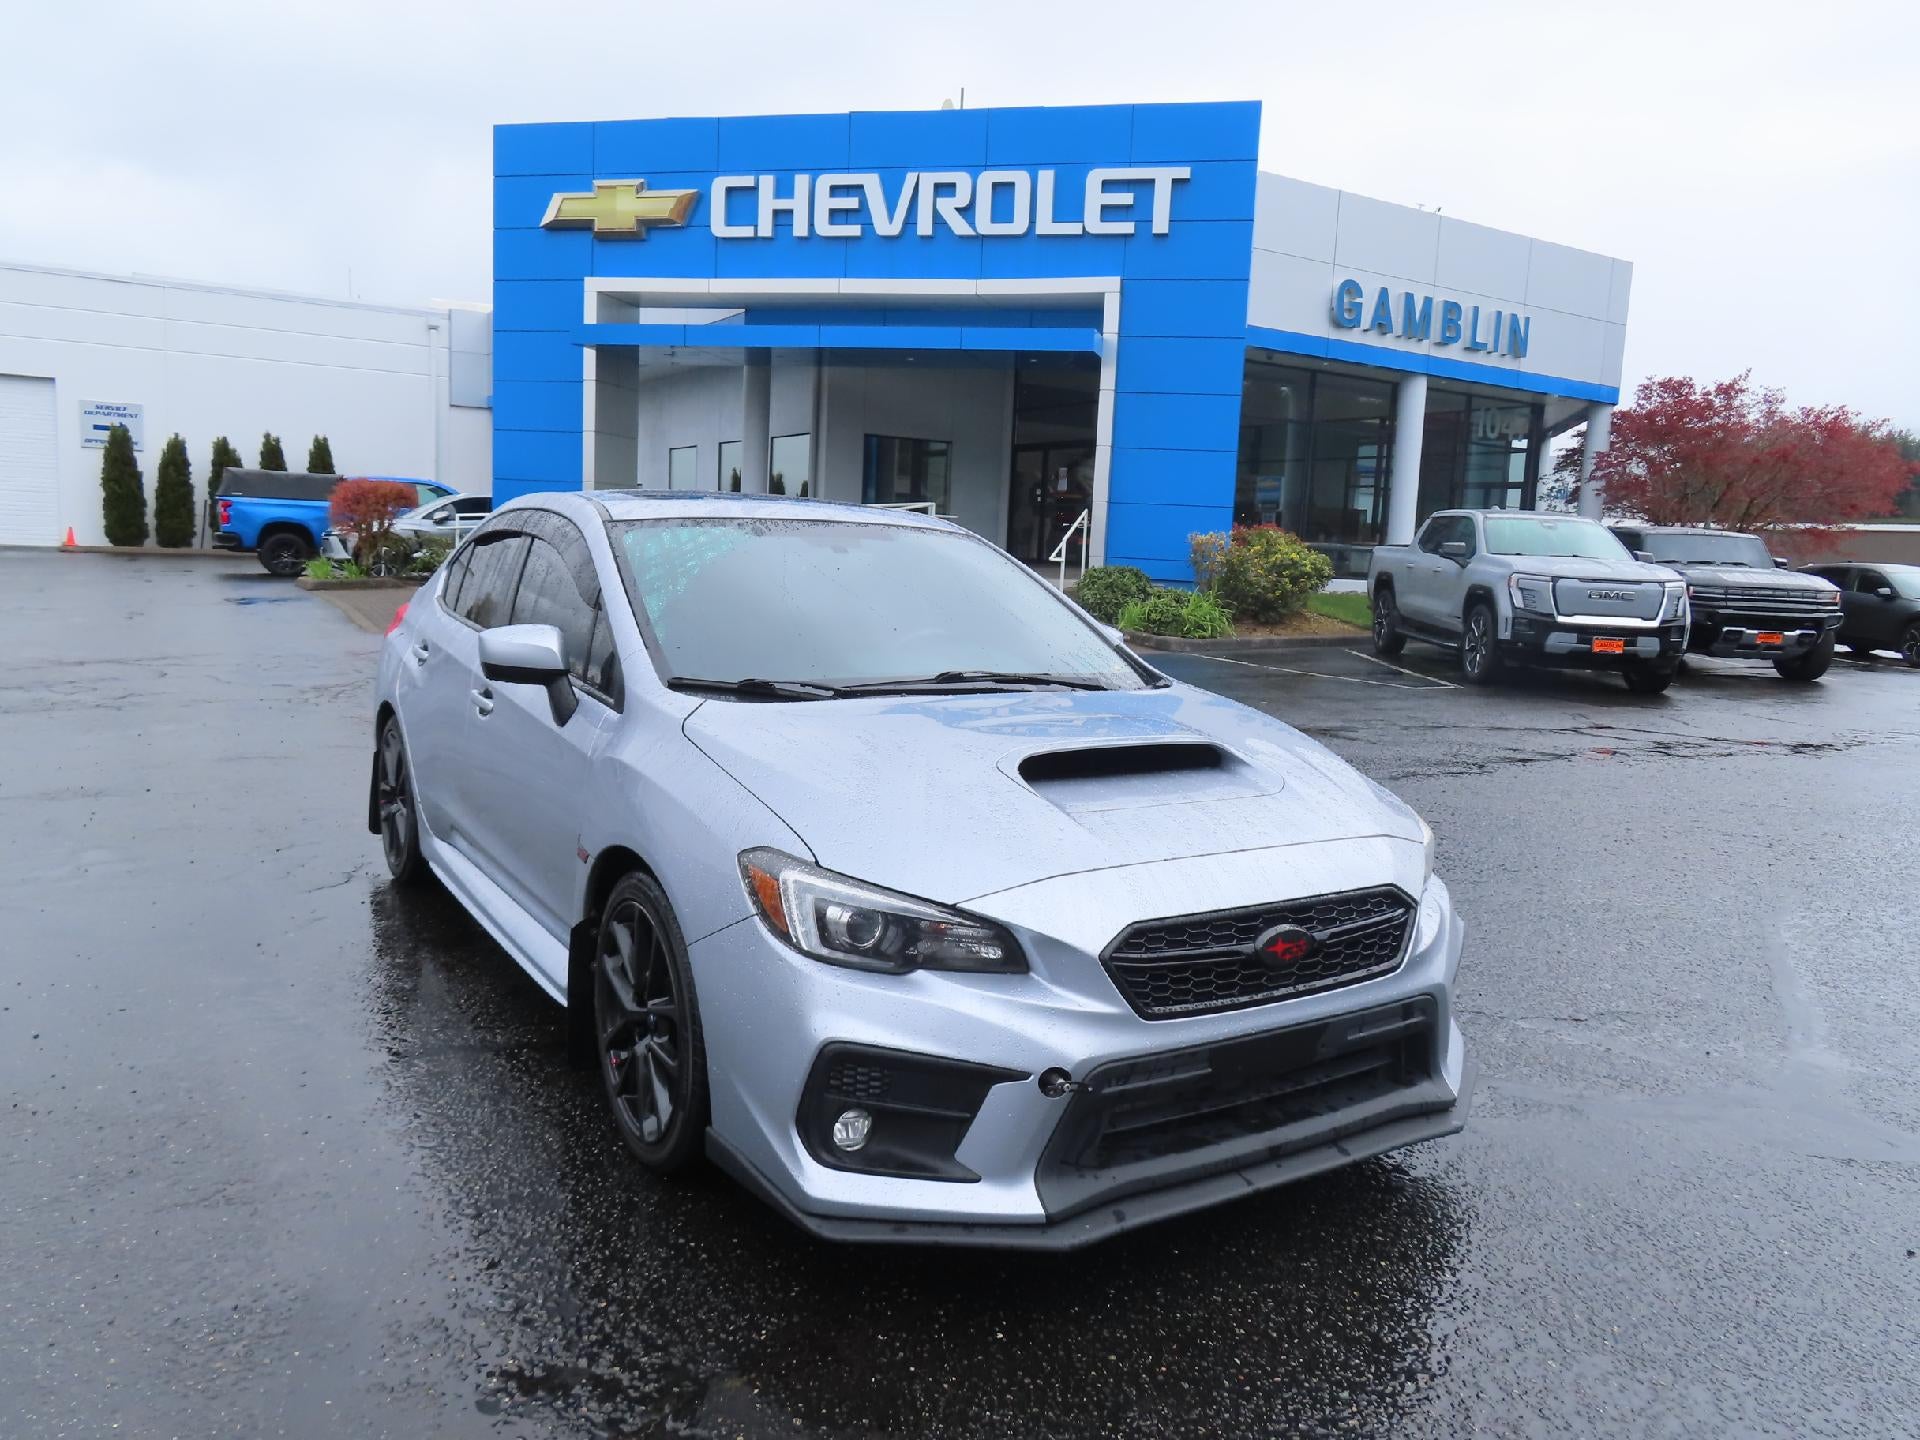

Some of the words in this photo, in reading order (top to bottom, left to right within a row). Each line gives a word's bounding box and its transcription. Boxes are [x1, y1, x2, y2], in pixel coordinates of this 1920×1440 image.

[709, 166, 1192, 239] CHEVROLET
[1332, 278, 1531, 359] GAMBLIN
[83, 410, 139, 419] DEPARTMENT
[1587, 589, 1636, 601] GMC
